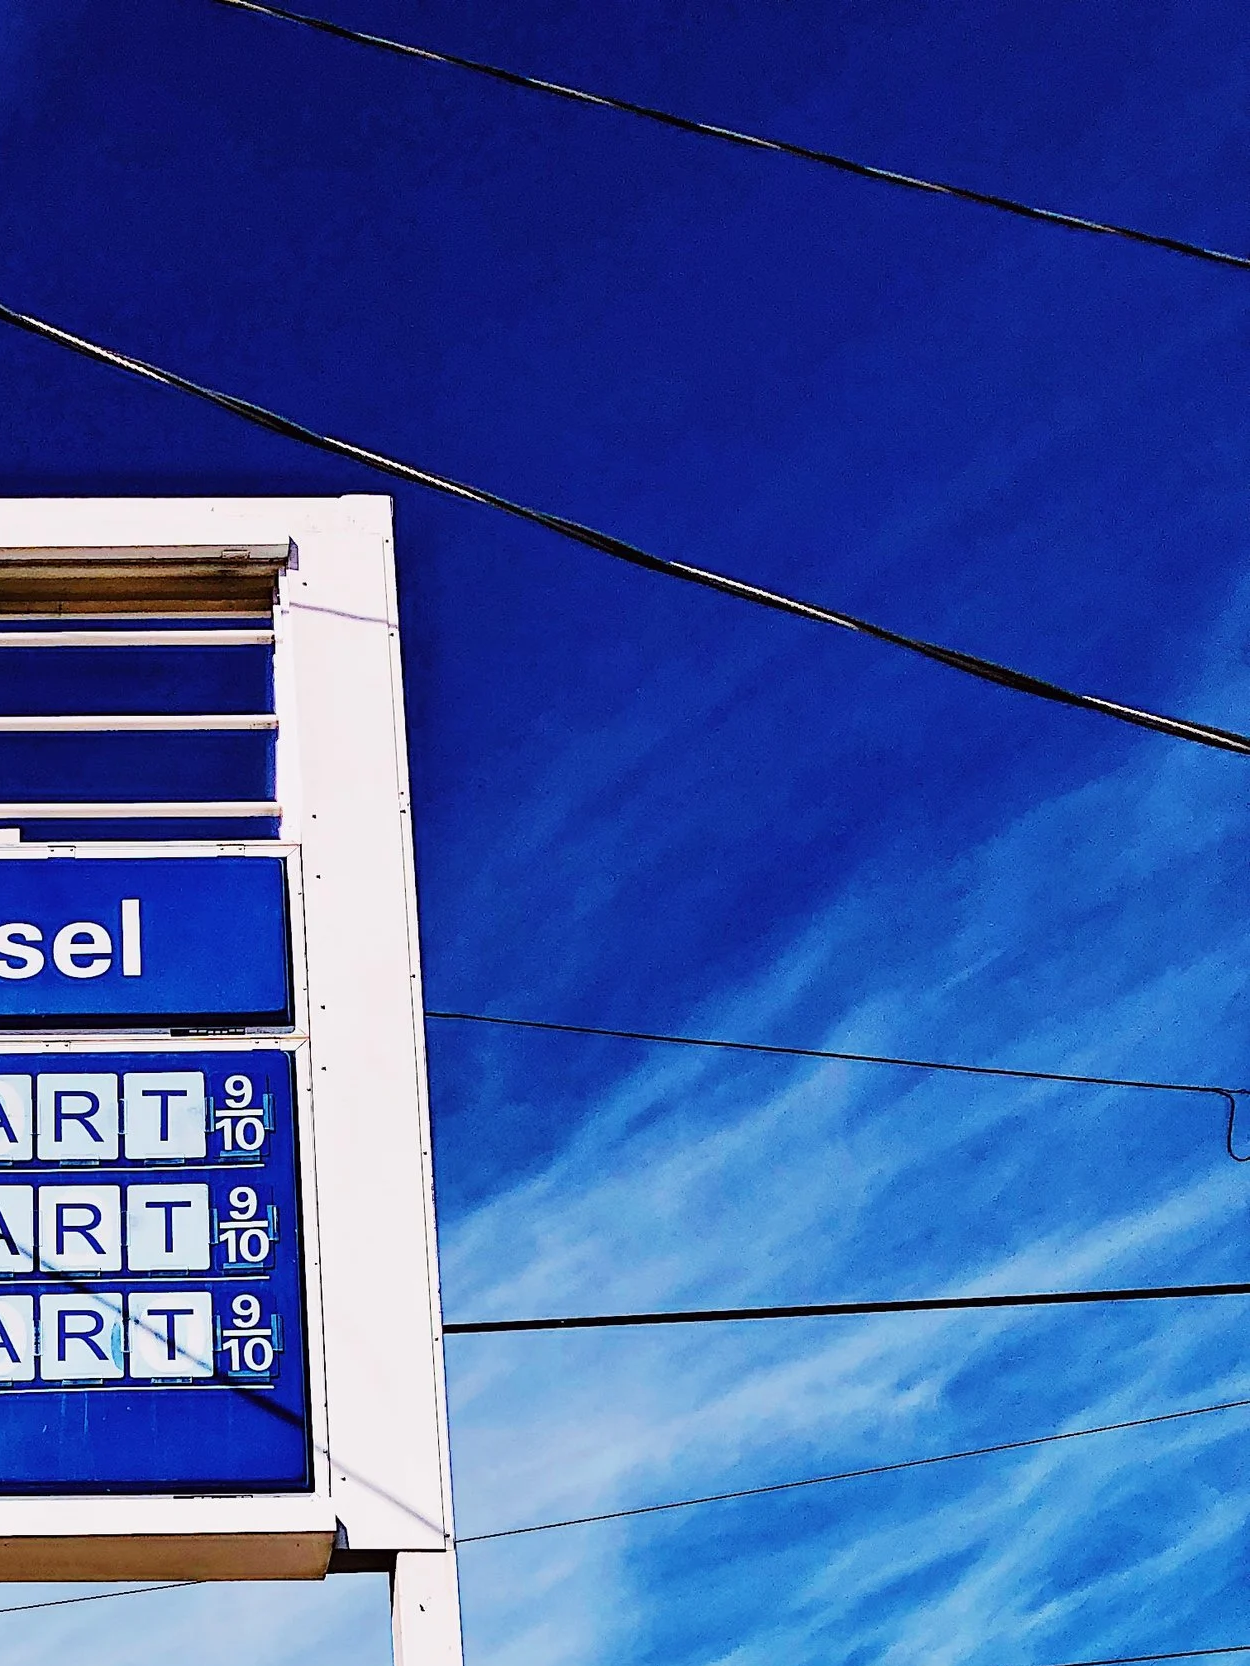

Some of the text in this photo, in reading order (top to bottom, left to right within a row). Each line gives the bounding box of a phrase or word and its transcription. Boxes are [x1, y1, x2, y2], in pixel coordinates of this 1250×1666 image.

[224, 1075, 253, 1109] 9
[215, 1117, 265, 1151] 10
[229, 1186, 257, 1220] 9
[219, 1228, 270, 1263] 10
[232, 1294, 260, 1328] 9
[222, 1337, 274, 1371] 10
